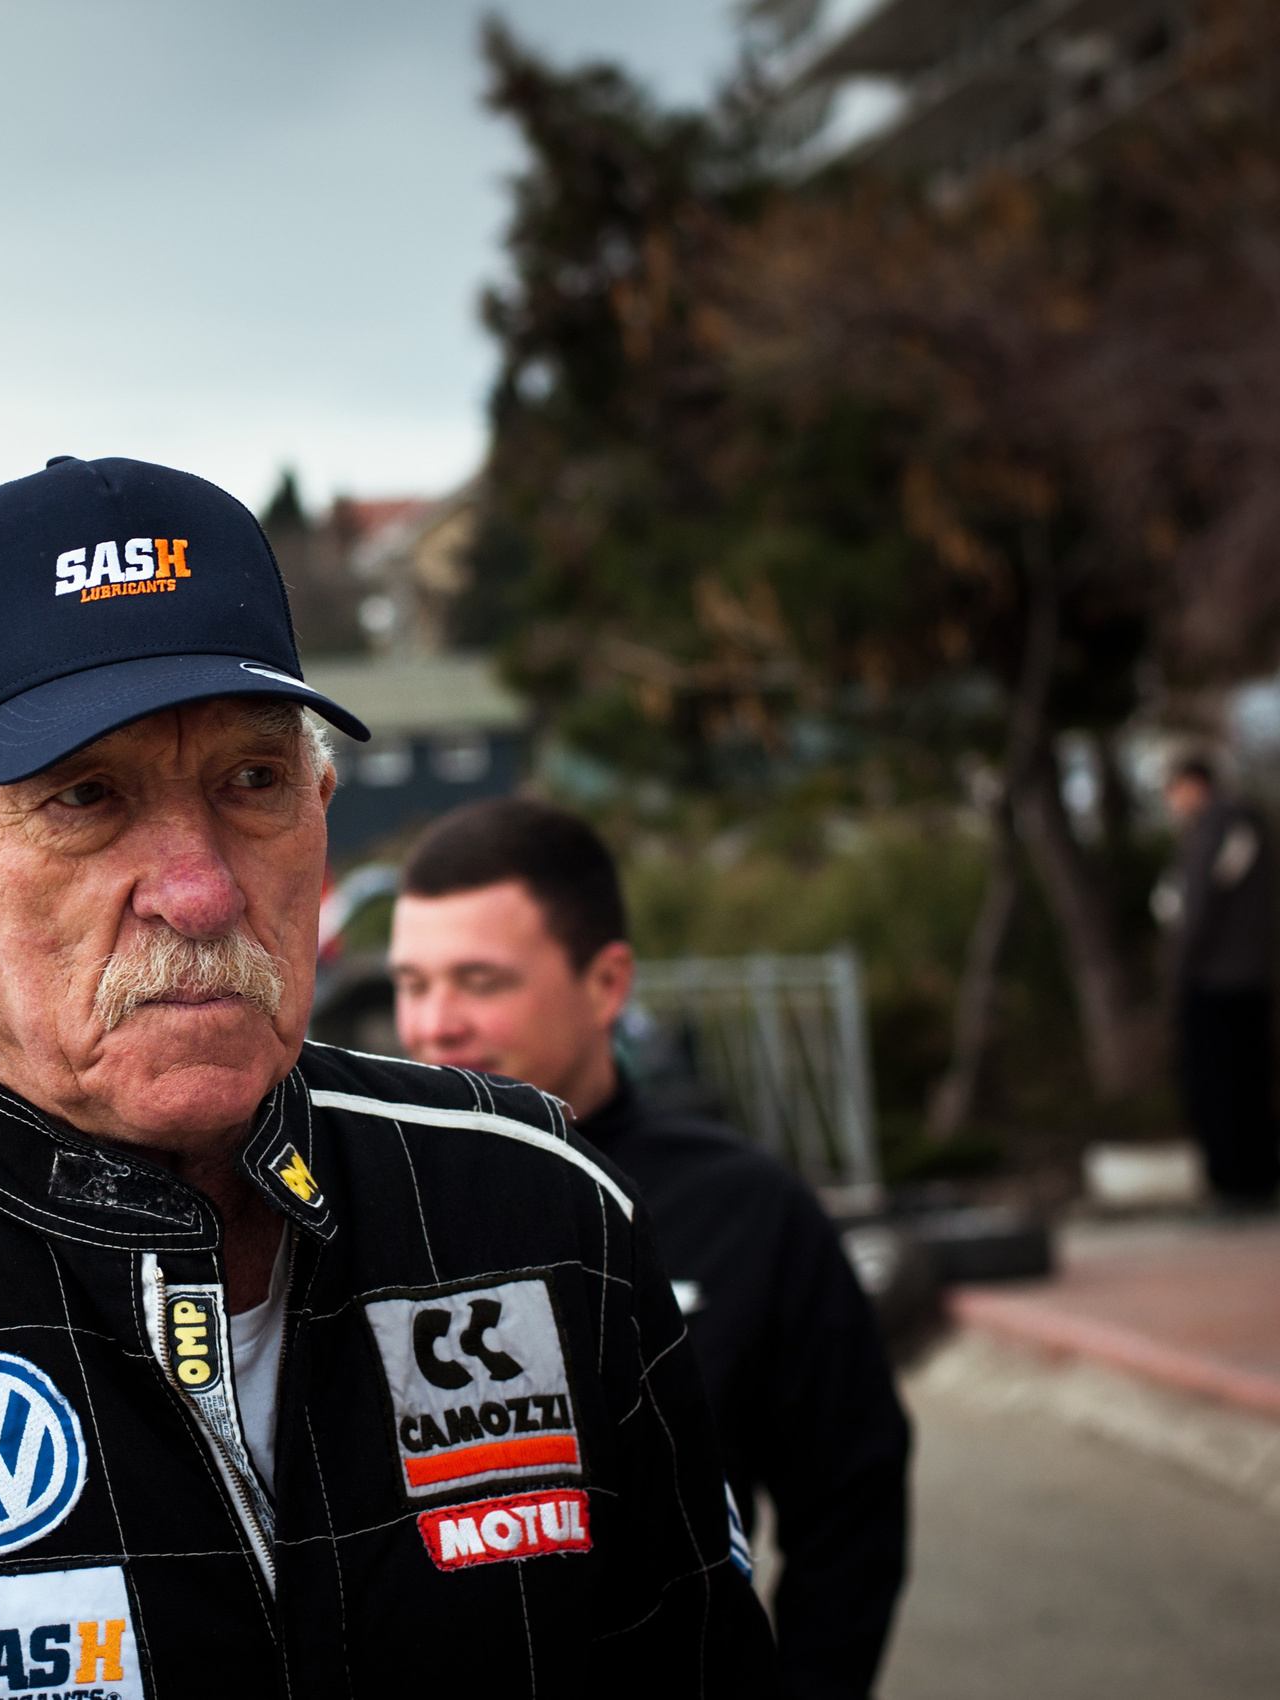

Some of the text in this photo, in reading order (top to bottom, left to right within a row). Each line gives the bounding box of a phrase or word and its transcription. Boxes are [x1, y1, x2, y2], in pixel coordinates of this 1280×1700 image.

[55, 537, 192, 596] SASH
[80, 579, 177, 603] LUBRICANTS
[173, 1301, 211, 1385] OMP
[399, 1393, 573, 1454] CAMOZZI
[438, 1500, 586, 1562] MOTUL
